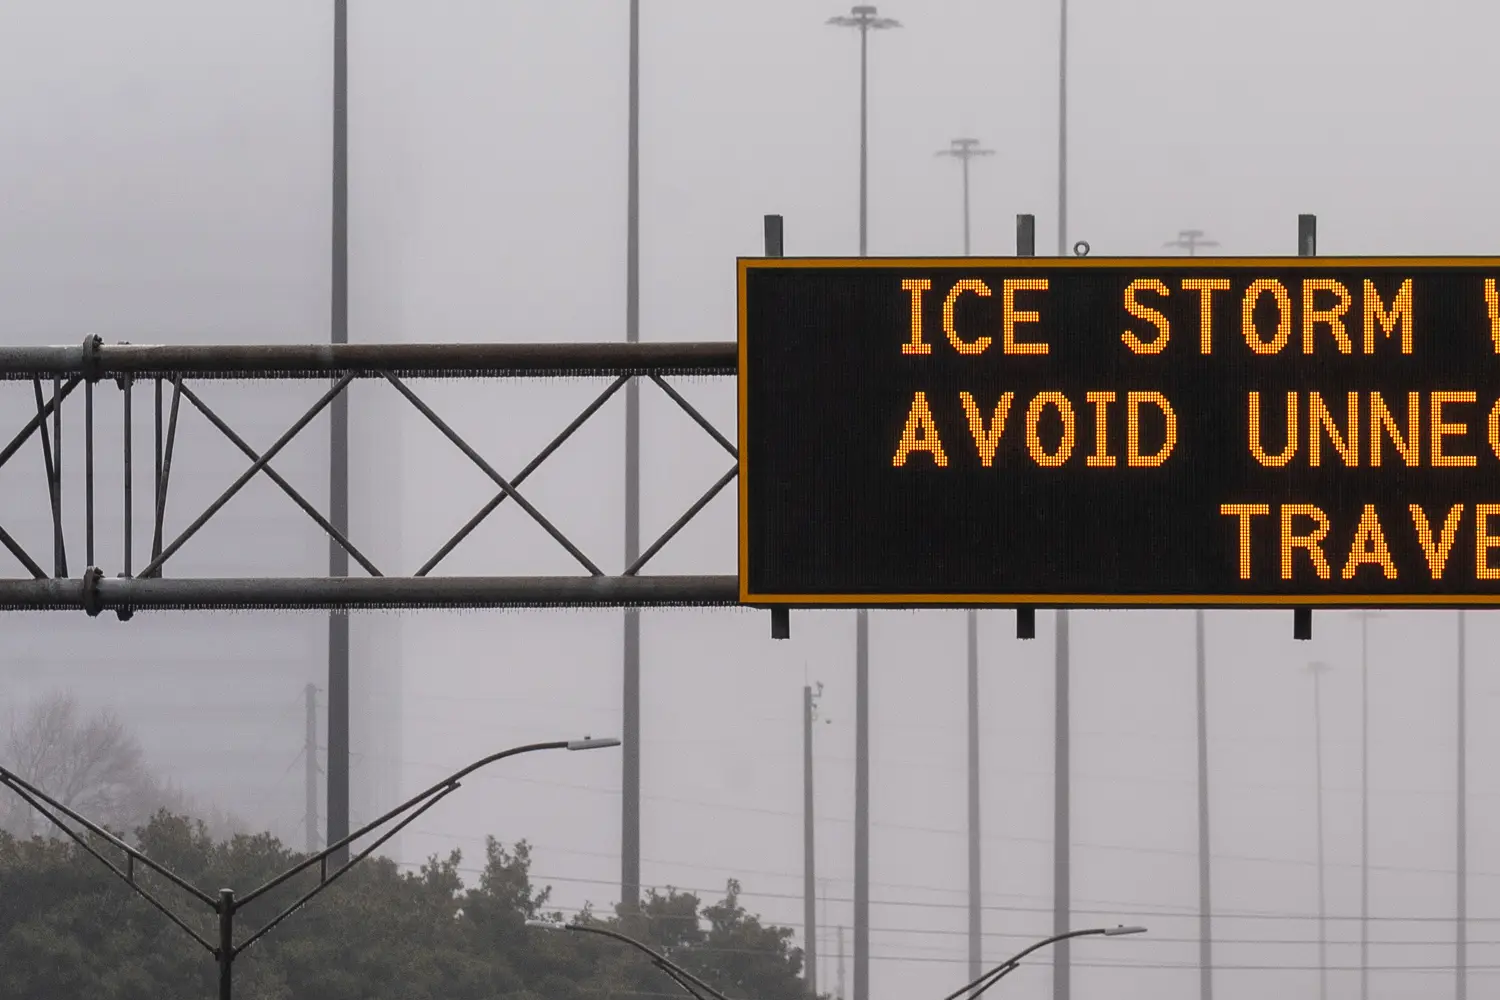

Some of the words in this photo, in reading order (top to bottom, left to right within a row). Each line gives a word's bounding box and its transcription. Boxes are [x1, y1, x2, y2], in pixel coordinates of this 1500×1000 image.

[902, 279, 1050, 356] ICE
[1122, 279, 1414, 356] STORM
[893, 391, 1178, 468] AVOID
